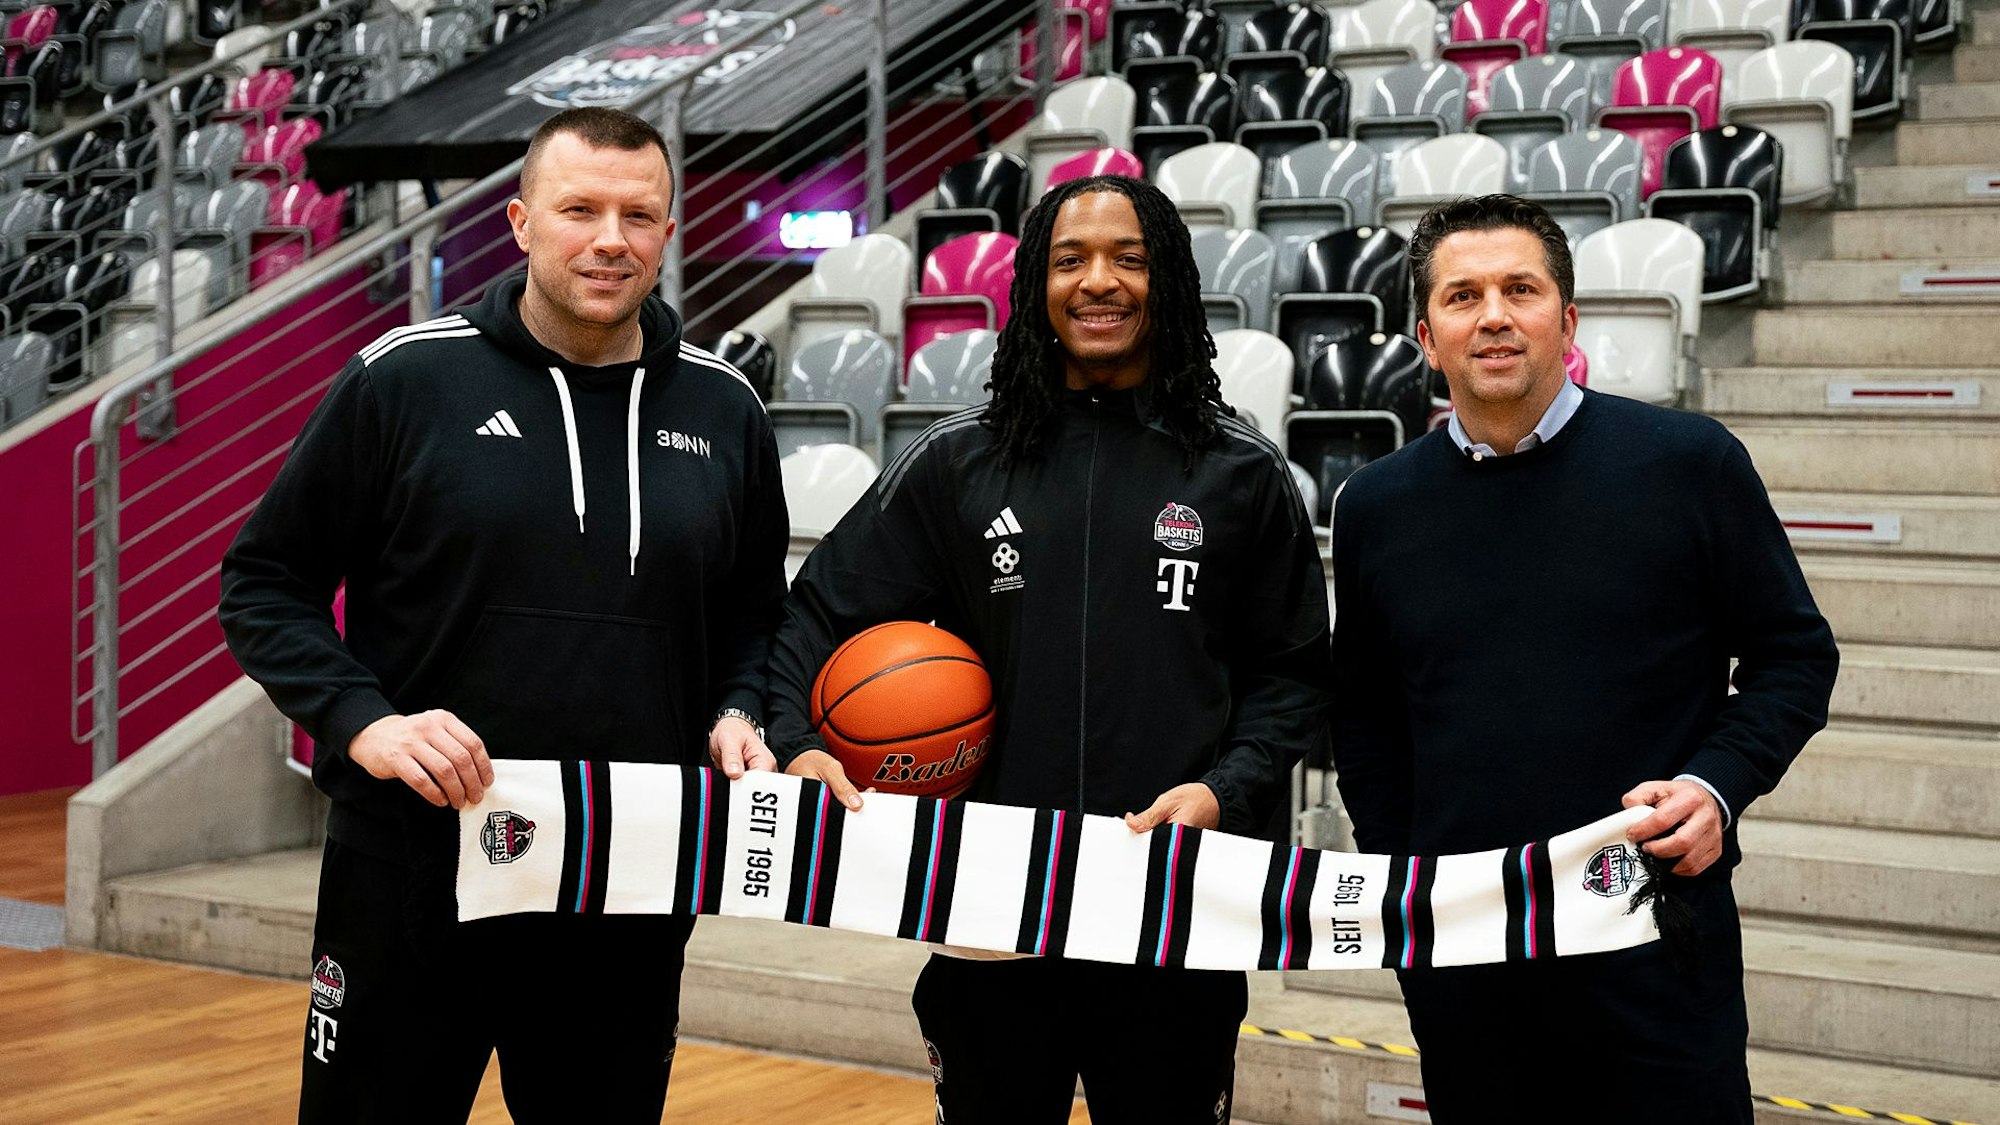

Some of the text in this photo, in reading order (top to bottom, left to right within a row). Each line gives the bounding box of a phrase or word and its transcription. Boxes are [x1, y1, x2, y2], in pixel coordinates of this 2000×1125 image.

[1157, 525, 1200, 542] BASKETS
[1163, 519, 1196, 530] TELEKOM
[872, 734, 991, 783] Baden
[493, 814, 509, 860] BASKETS
[742, 791, 778, 898] SEIT 1995
[1601, 857, 1611, 888] TELEKOM
[1607, 849, 1623, 893] BASKETS
[1331, 873, 1365, 954] SEIT 1995
[311, 975, 342, 1004] BASKETS
